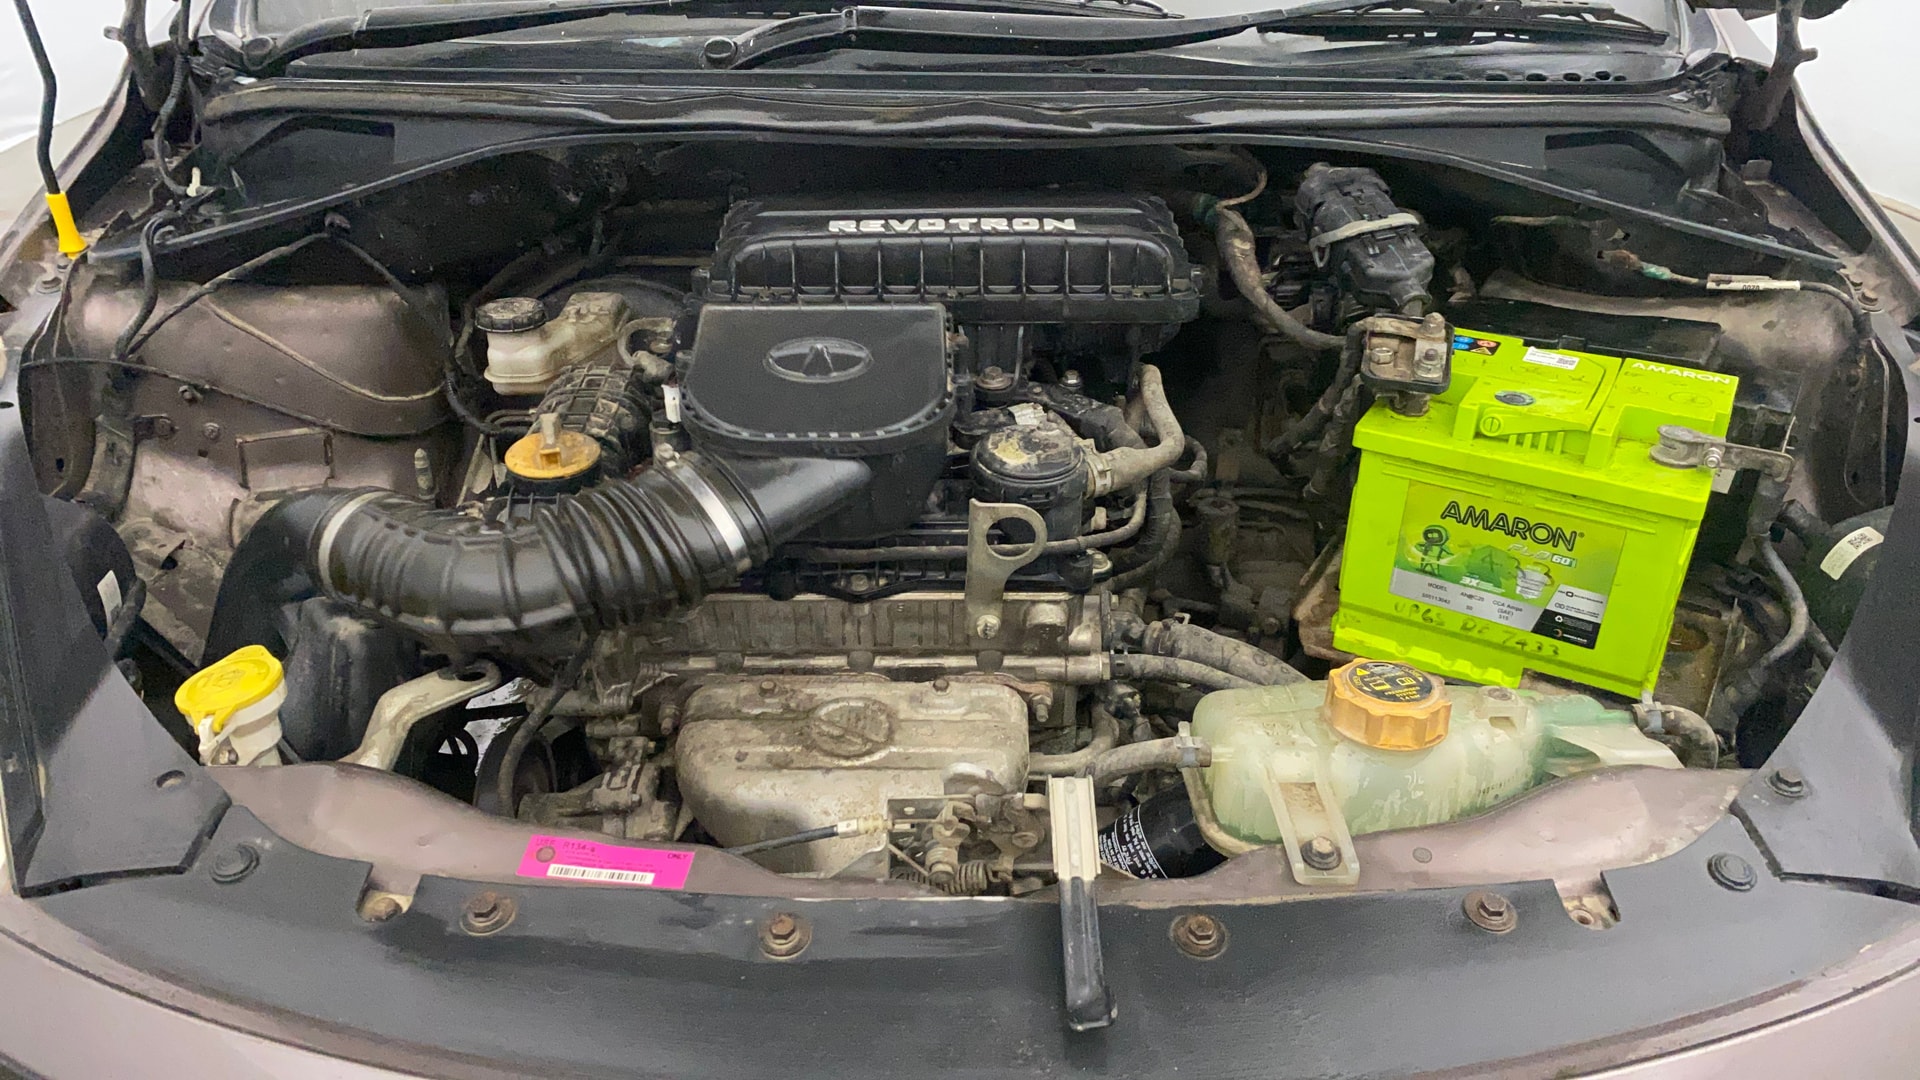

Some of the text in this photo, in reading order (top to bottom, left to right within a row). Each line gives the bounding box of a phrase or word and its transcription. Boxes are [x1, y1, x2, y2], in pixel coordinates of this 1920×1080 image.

[828, 217, 1076, 233] REVOTRON
[1631, 361, 1731, 385] AMARON
[1441, 501, 1578, 552] AMARON
[1428, 582, 1448, 592] MODEL
